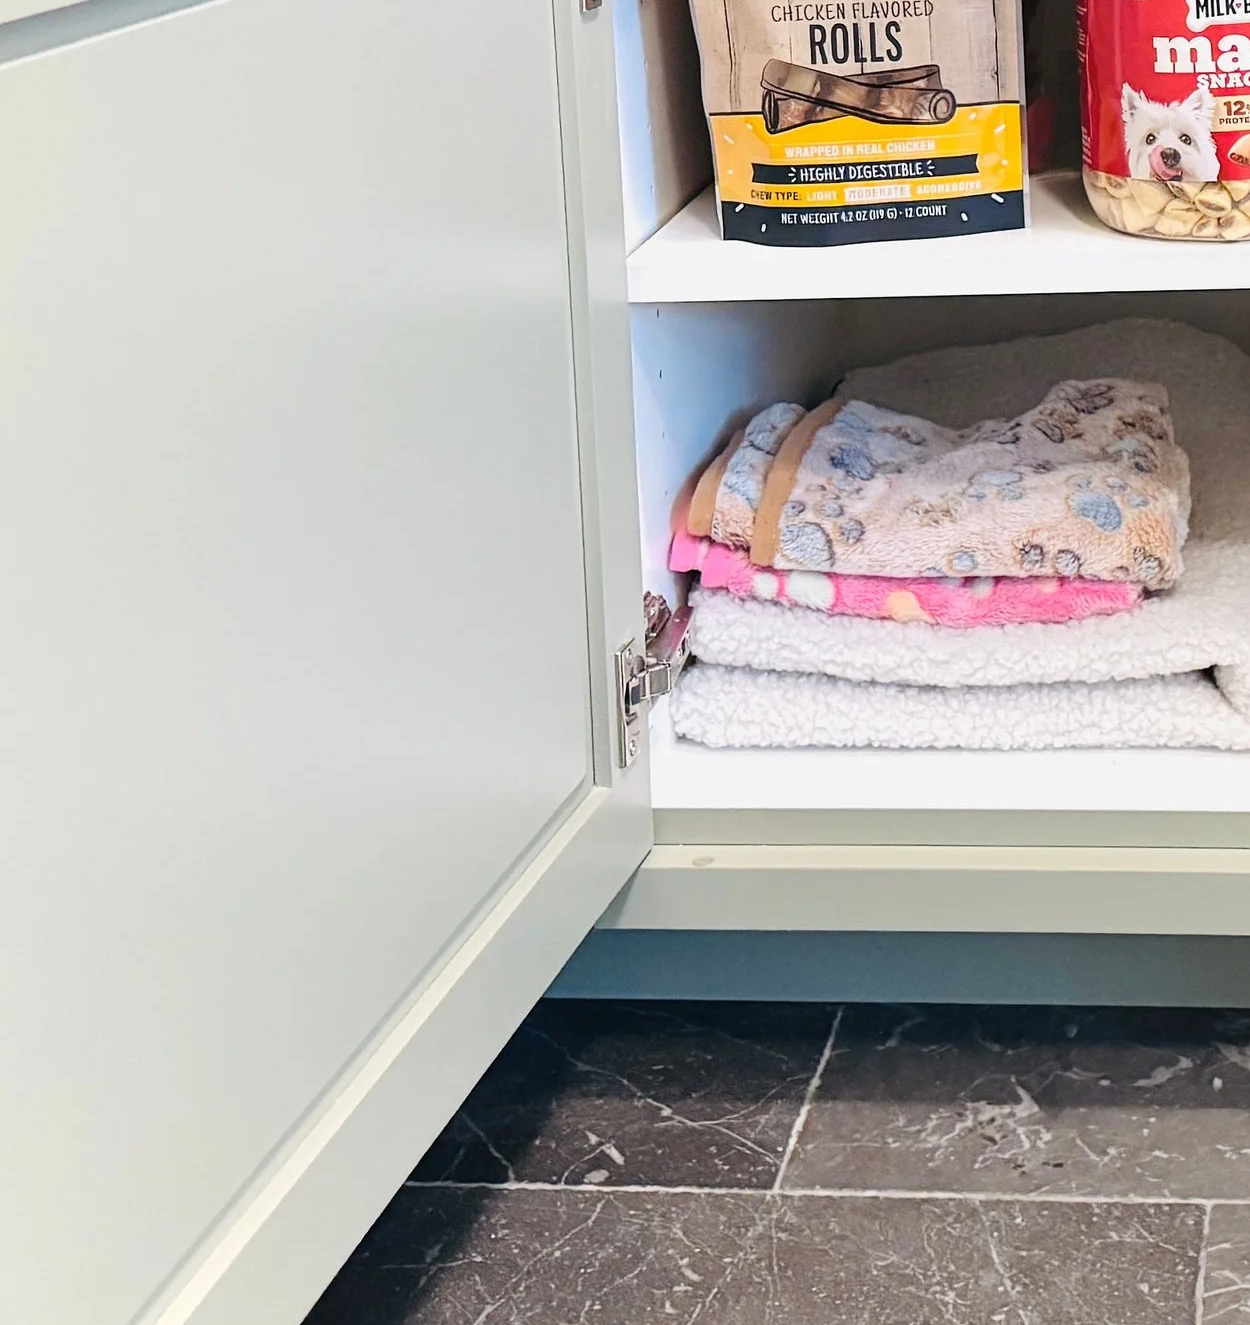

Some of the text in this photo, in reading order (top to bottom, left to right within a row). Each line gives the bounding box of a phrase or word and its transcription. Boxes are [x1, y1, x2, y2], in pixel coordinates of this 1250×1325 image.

[771, 0, 934, 23] CHICKEN FLAVORED
[809, 21, 903, 65] ROLLS
[784, 140, 935, 158] WRAPPED IN REAL CHICKEN
[800, 162, 924, 182] HIGHLY DIGESTIBLE
[750, 189, 772, 200] CHEW
[781, 212, 797, 224] NET
[800, 212, 839, 224] WEIGHT
[841, 211, 853, 222] 4.2
[855, 210, 868, 221] OZ
[905, 207, 914, 218] 12
[916, 205, 948, 217] COUNT
